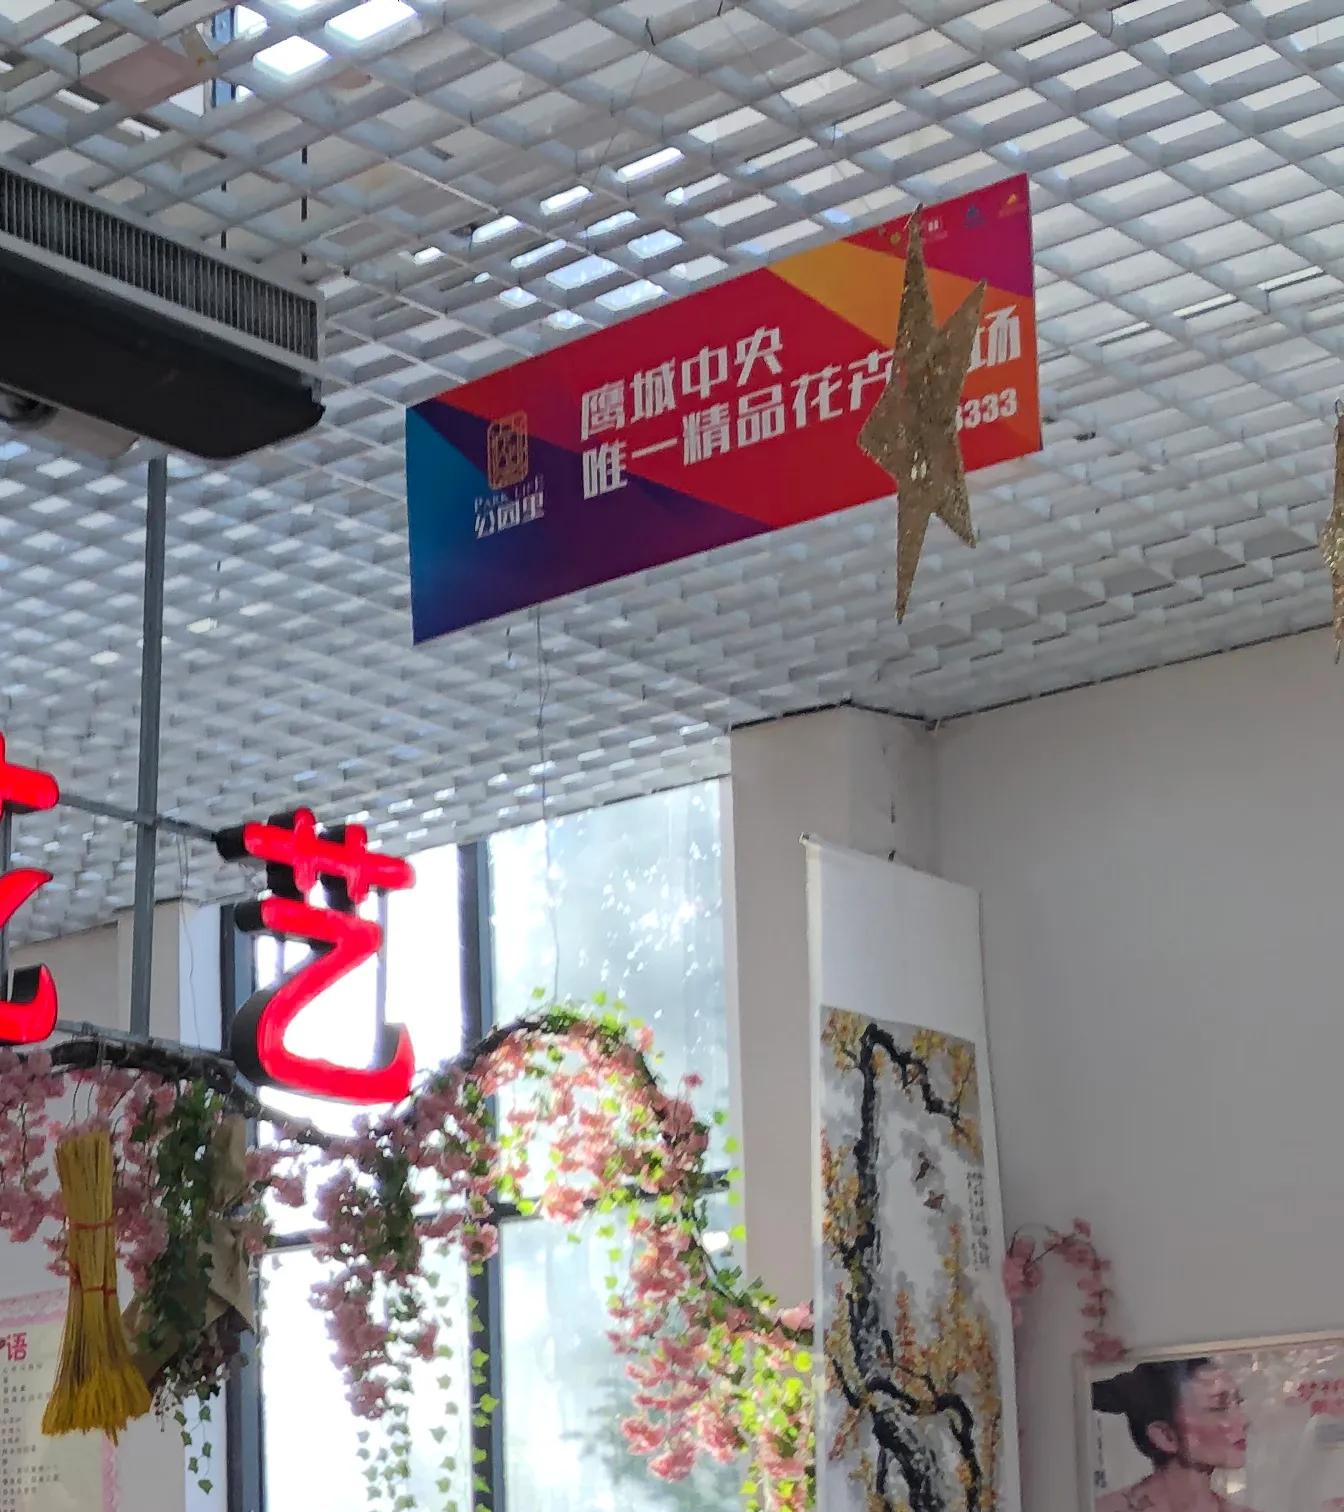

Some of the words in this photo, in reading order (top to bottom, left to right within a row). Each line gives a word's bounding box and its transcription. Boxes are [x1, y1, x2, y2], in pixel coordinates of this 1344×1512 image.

[580, 325, 785, 441] 鹰城中央
[582, 303, 1022, 500] 唯一精品花卉场
